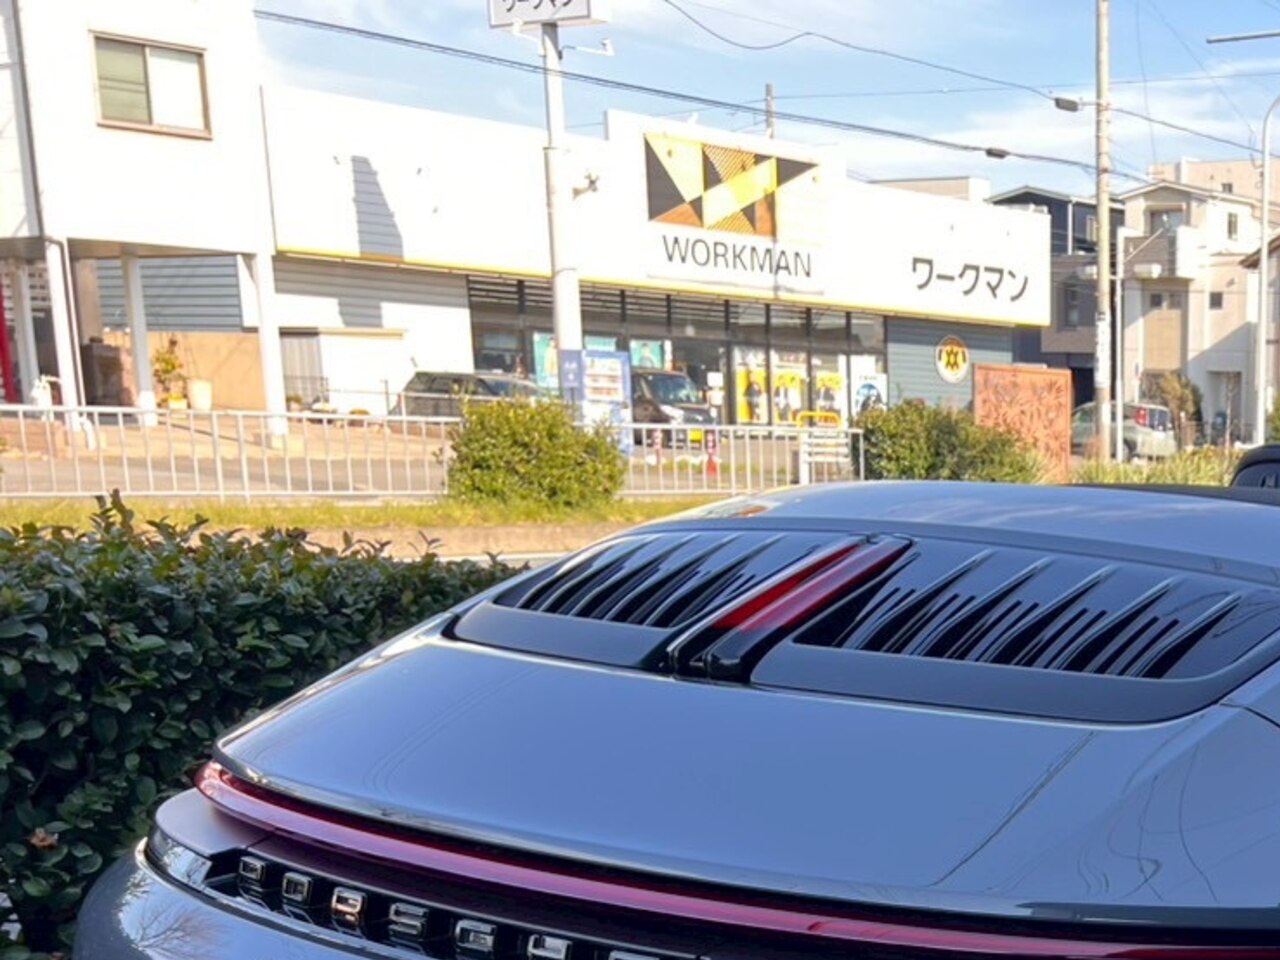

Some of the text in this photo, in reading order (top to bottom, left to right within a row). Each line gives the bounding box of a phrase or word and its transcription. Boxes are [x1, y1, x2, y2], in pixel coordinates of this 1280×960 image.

[662, 235, 812, 278] WORKMAN
[912, 256, 1029, 302] ワークマン
